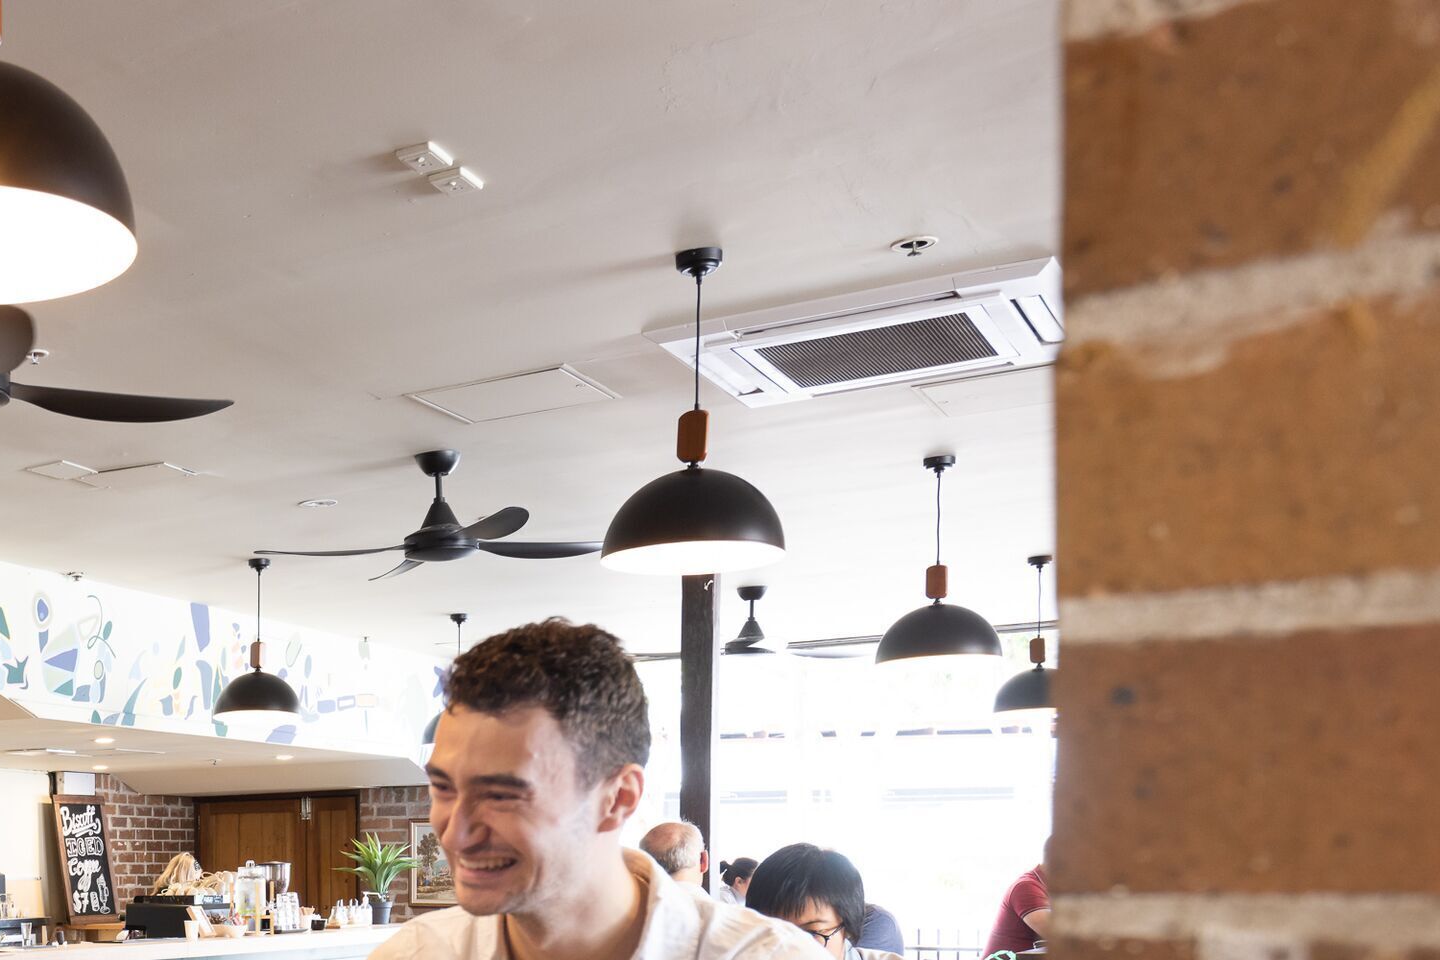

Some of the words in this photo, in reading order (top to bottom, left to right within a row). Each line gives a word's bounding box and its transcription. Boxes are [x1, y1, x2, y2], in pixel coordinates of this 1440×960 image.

[60, 805, 101, 836] Biscoff
[65, 836, 104, 857] ICED
[73, 890, 89, 913] $7
